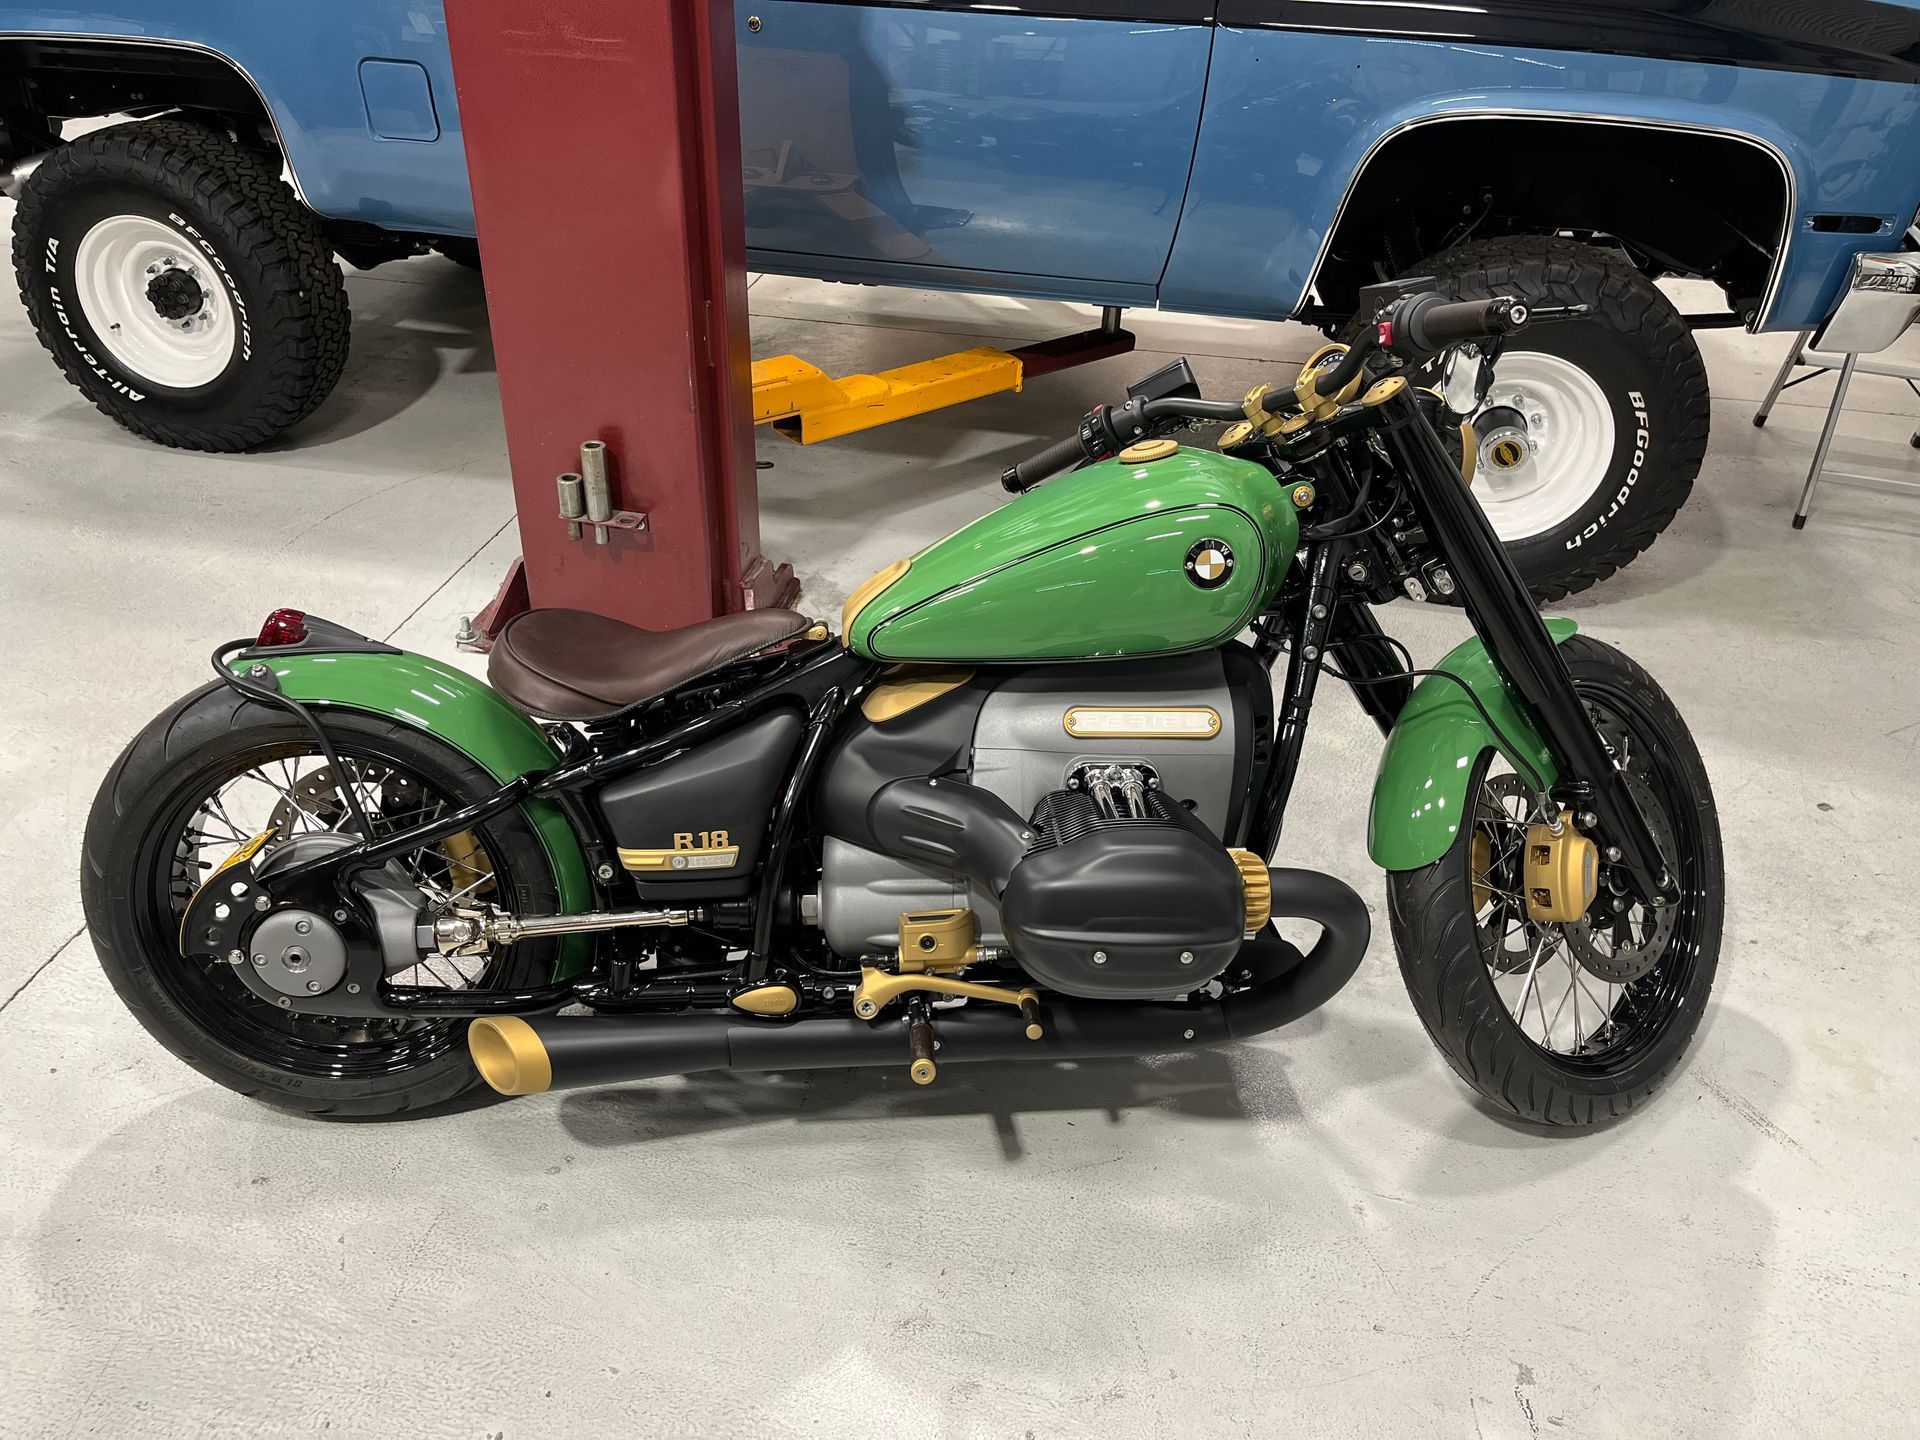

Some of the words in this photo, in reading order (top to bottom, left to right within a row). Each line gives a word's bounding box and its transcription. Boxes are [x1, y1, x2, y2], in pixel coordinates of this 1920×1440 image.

[45, 237, 60, 273] T/A
[168, 212, 251, 361] BFGoodrich
[50, 286, 146, 402] All-Terrain
[1562, 391, 1649, 550] BFGoodrich
[1190, 540, 1230, 558] BMW
